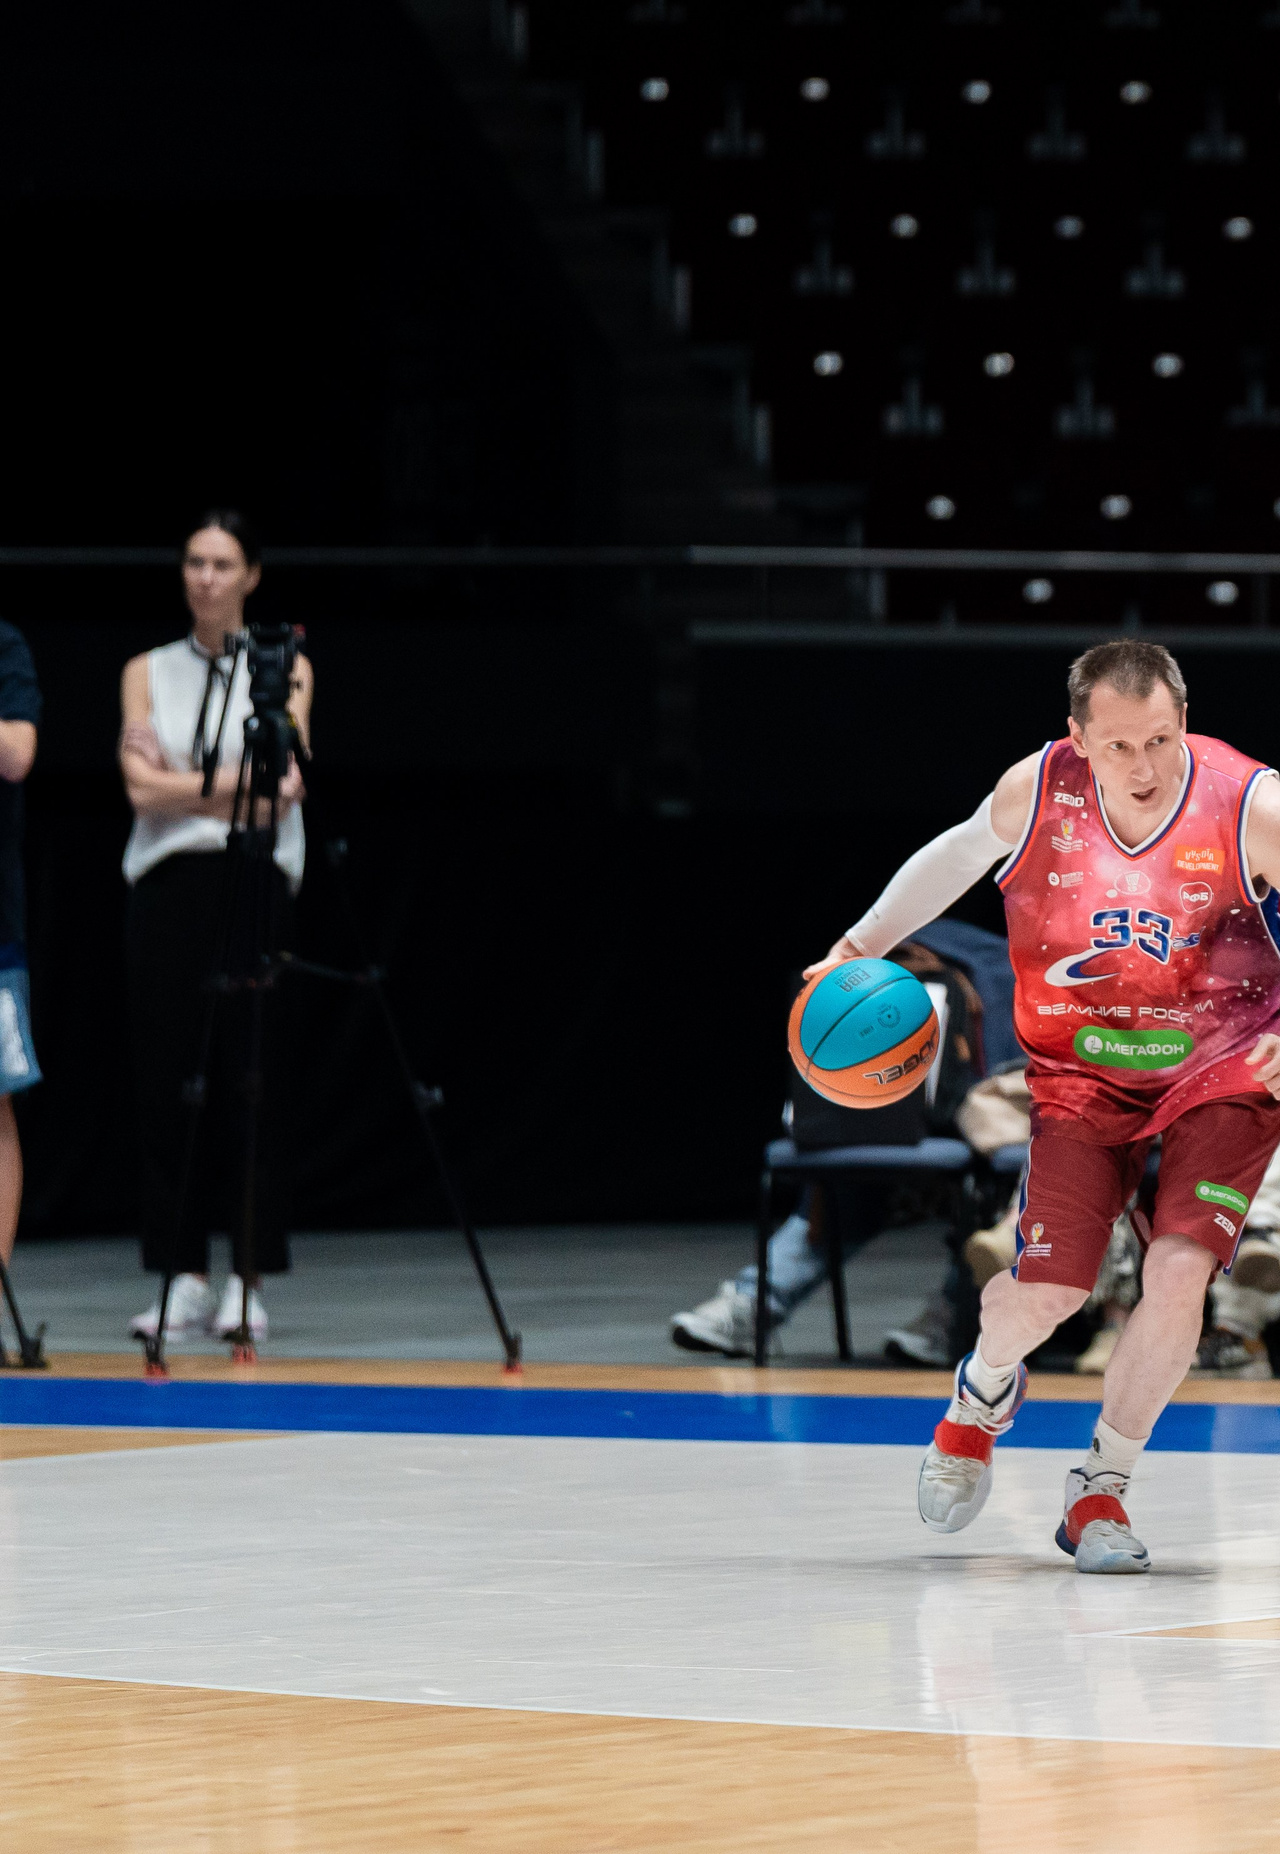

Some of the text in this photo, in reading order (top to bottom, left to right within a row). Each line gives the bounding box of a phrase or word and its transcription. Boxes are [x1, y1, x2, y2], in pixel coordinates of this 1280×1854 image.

[1182, 890, 1209, 902] РФБ
[1091, 909, 1173, 964] 33
[840, 966, 871, 993] FIBA
[1037, 1003, 1131, 1018] ВЕЛИЧИЕ
[1105, 1040, 1185, 1056] МЕГАФОН
